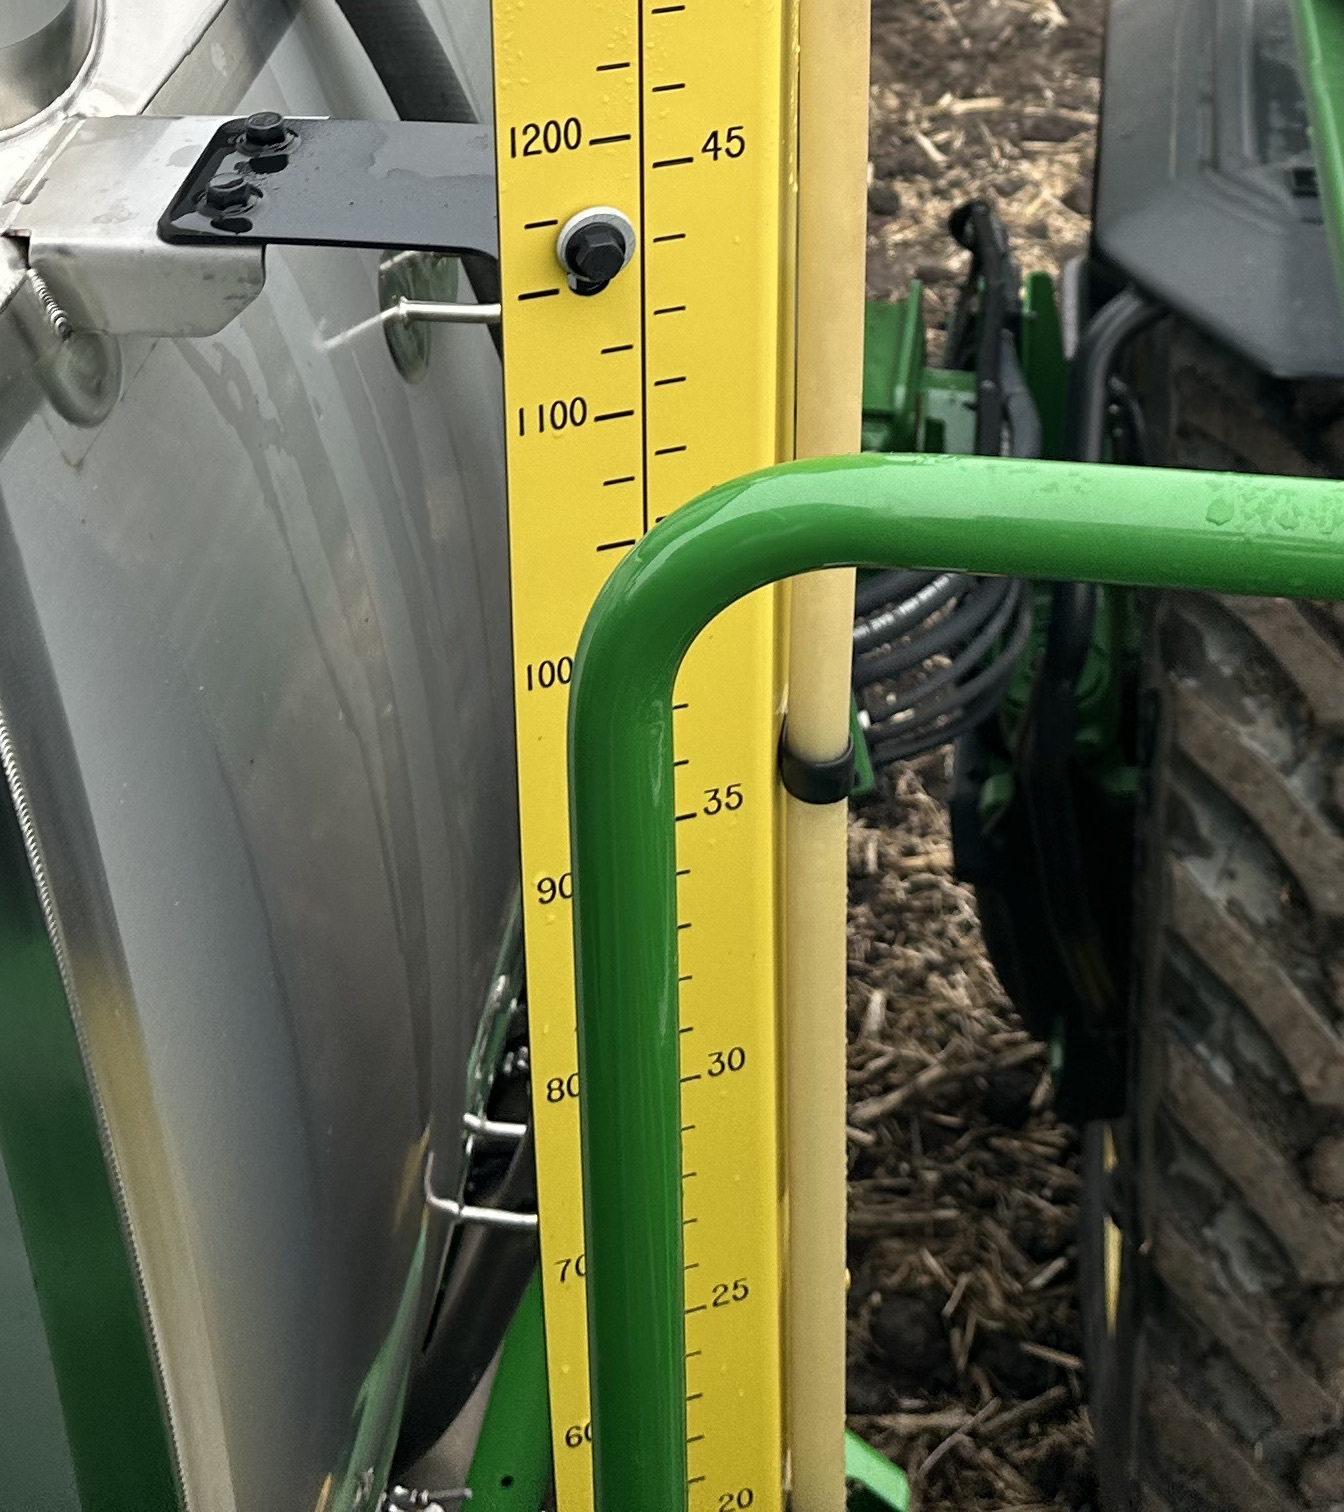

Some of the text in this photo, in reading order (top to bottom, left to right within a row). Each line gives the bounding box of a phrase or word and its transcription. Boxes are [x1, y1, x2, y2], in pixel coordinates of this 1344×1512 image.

[510, 117, 582, 159] 1200
[701, 125, 746, 161] 45
[518, 397, 587, 436] 1100
[526, 656, 573, 691] 100
[702, 783, 744, 815] 35
[536, 872, 573, 905] 90
[706, 1046, 746, 1077] 30
[546, 1073, 580, 1103] 80
[711, 1278, 749, 1308] 25
[718, 1488, 754, 1512] 20
